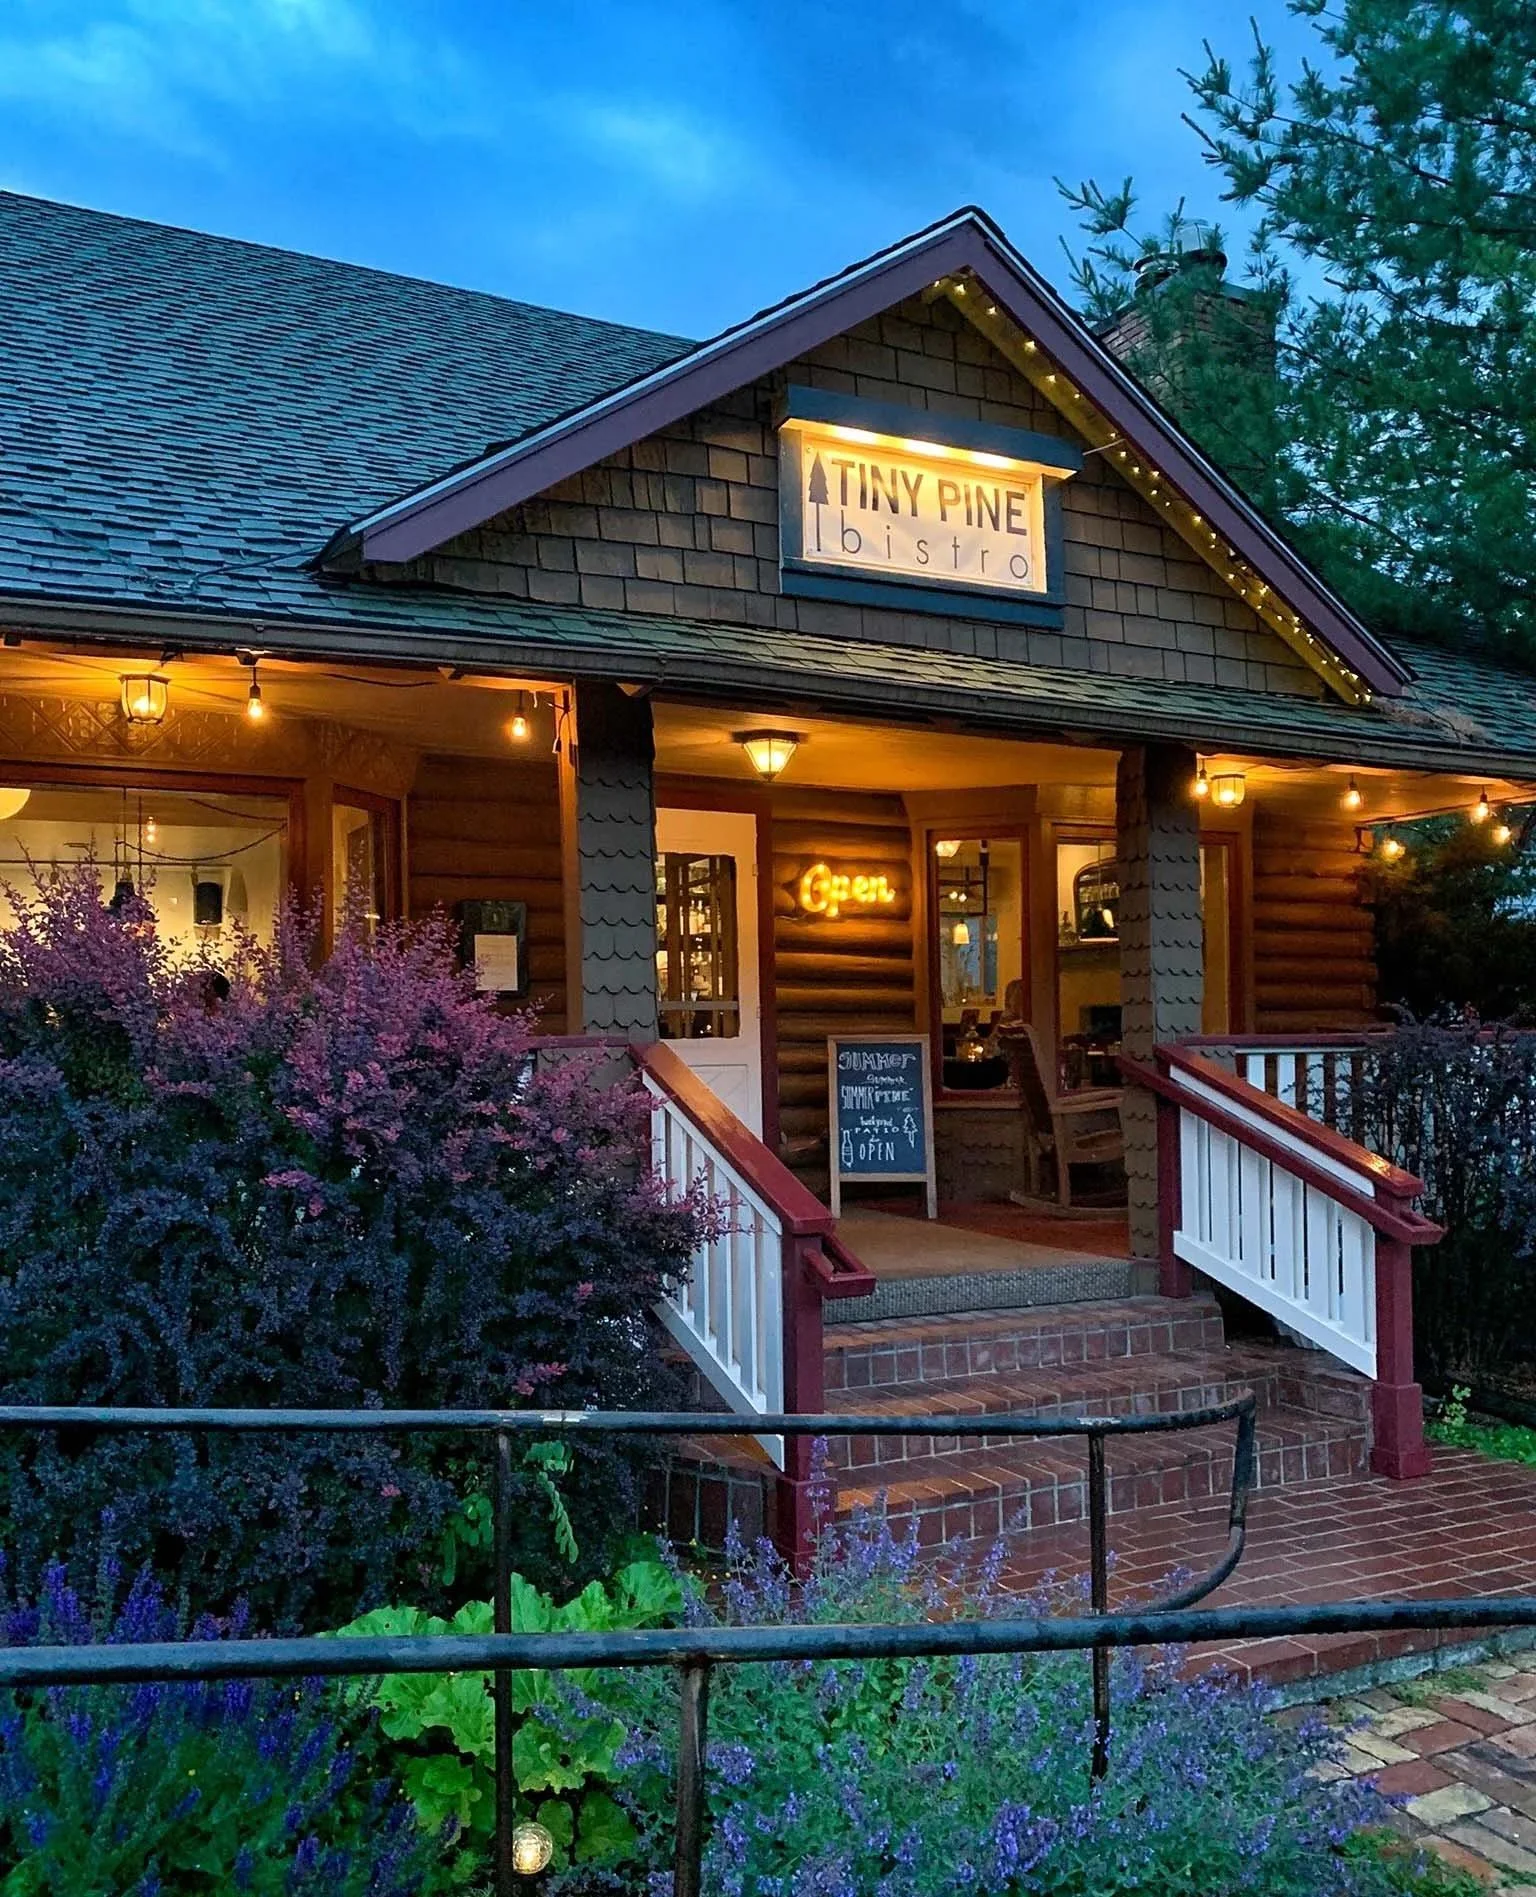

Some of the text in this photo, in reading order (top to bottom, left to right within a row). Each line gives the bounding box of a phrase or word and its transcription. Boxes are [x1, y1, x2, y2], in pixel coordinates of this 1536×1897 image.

[832, 459, 1028, 536] TINY PINE
[840, 509, 1029, 579] bistro
[800, 863, 896, 917] Open
[854, 1126, 900, 1134] PATIO
[859, 1142, 895, 1161] OPEN
